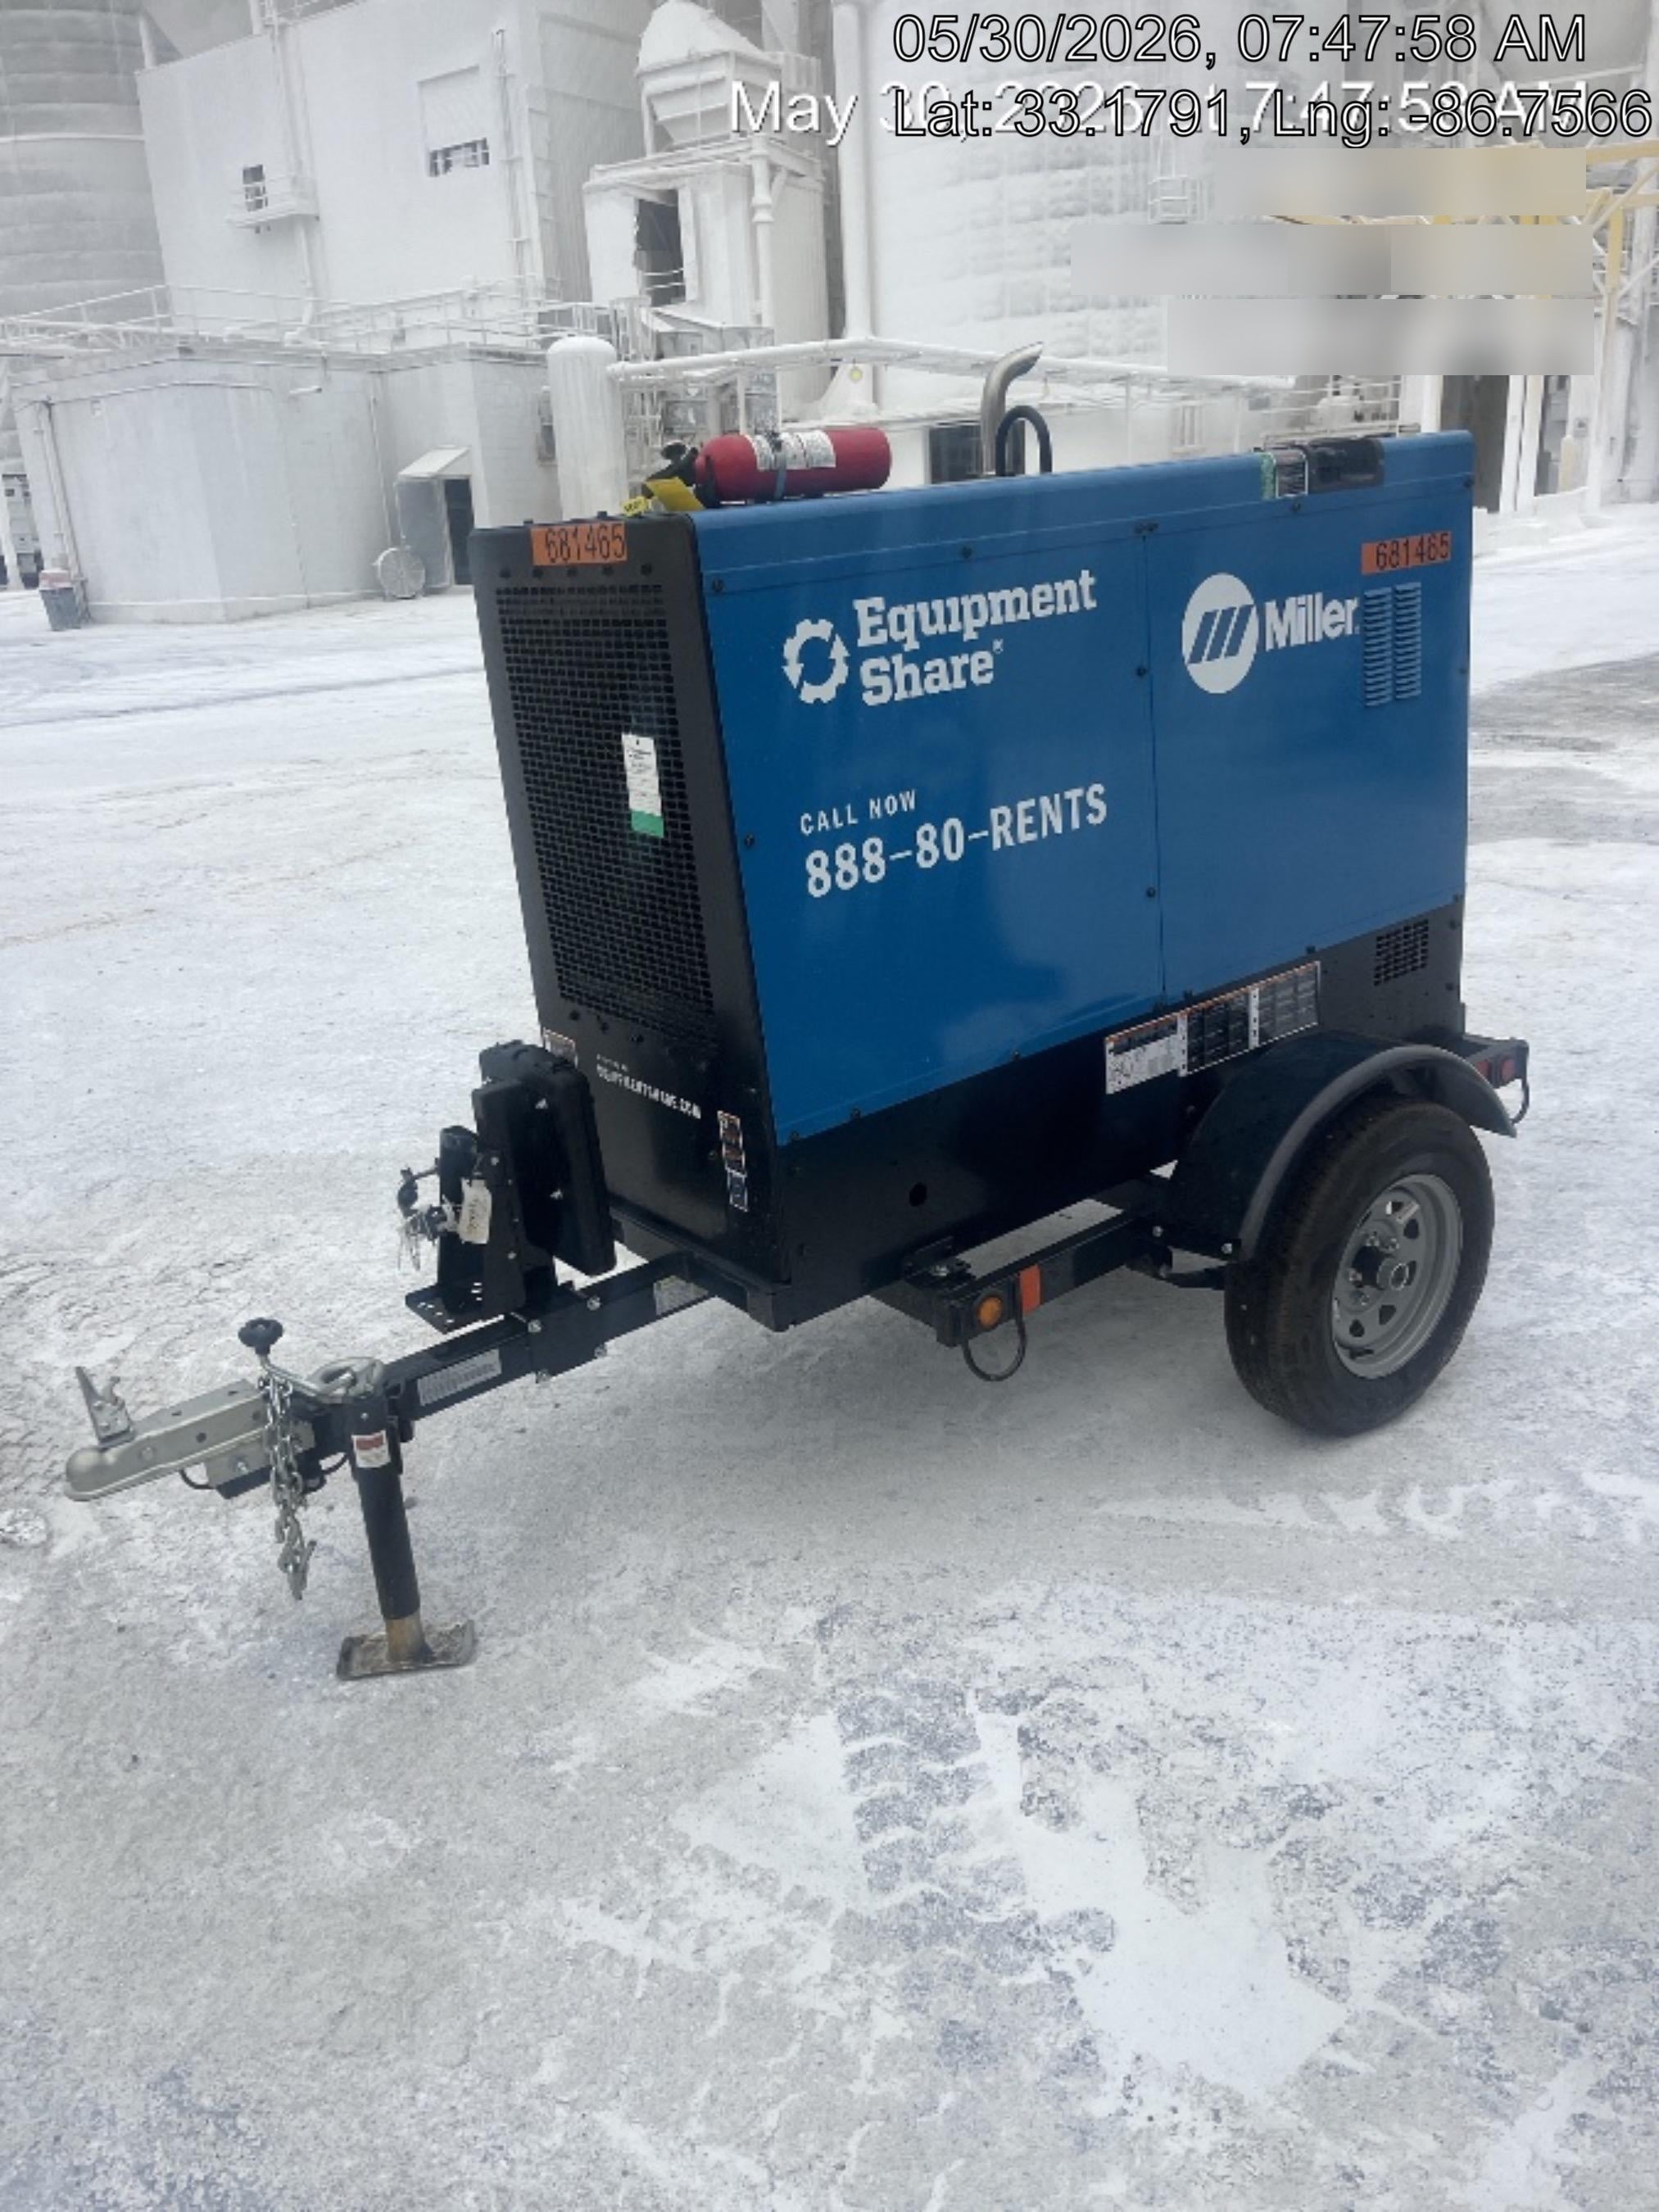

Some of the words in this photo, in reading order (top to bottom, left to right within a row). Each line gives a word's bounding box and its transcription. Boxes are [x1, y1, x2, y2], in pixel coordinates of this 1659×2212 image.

[544, 522, 625, 564] 681465
[1376, 532, 1450, 571] 681465
[853, 569, 1098, 652] Equipment
[1264, 591, 1360, 653] Miller
[800, 805, 859, 836] CALL
[868, 789, 917, 820] NOW
[805, 783, 1108, 898] 888-80-RENTS
